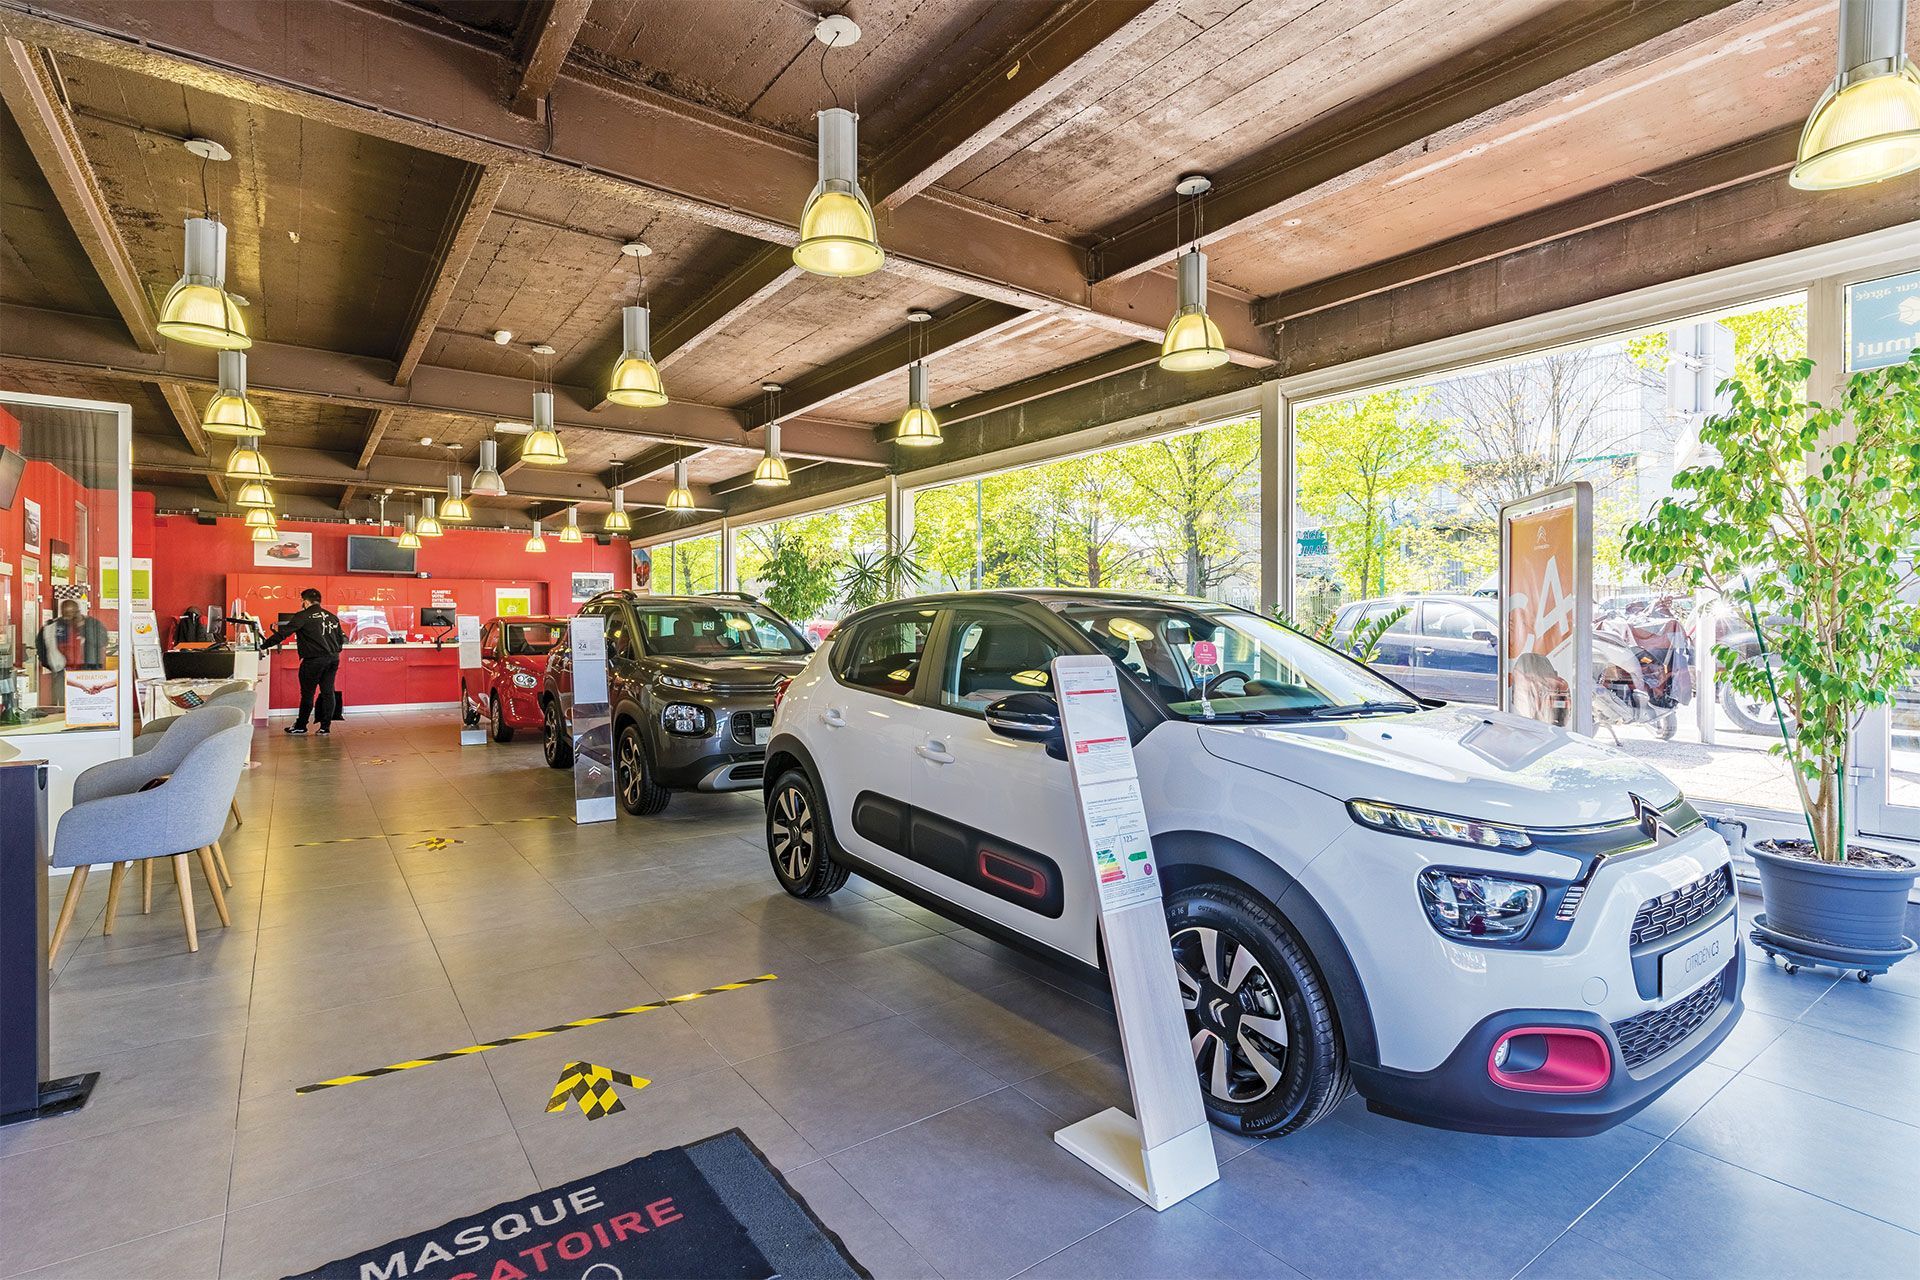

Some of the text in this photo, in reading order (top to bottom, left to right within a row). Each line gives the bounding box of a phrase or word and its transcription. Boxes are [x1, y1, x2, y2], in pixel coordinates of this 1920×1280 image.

[1123, 835, 1133, 844] 123
[1177, 906, 1185, 915] 16
[1711, 940, 1720, 957] C3
[359, 1186, 605, 1280] MASQUE
[449, 1197, 685, 1280] ATOIRE
